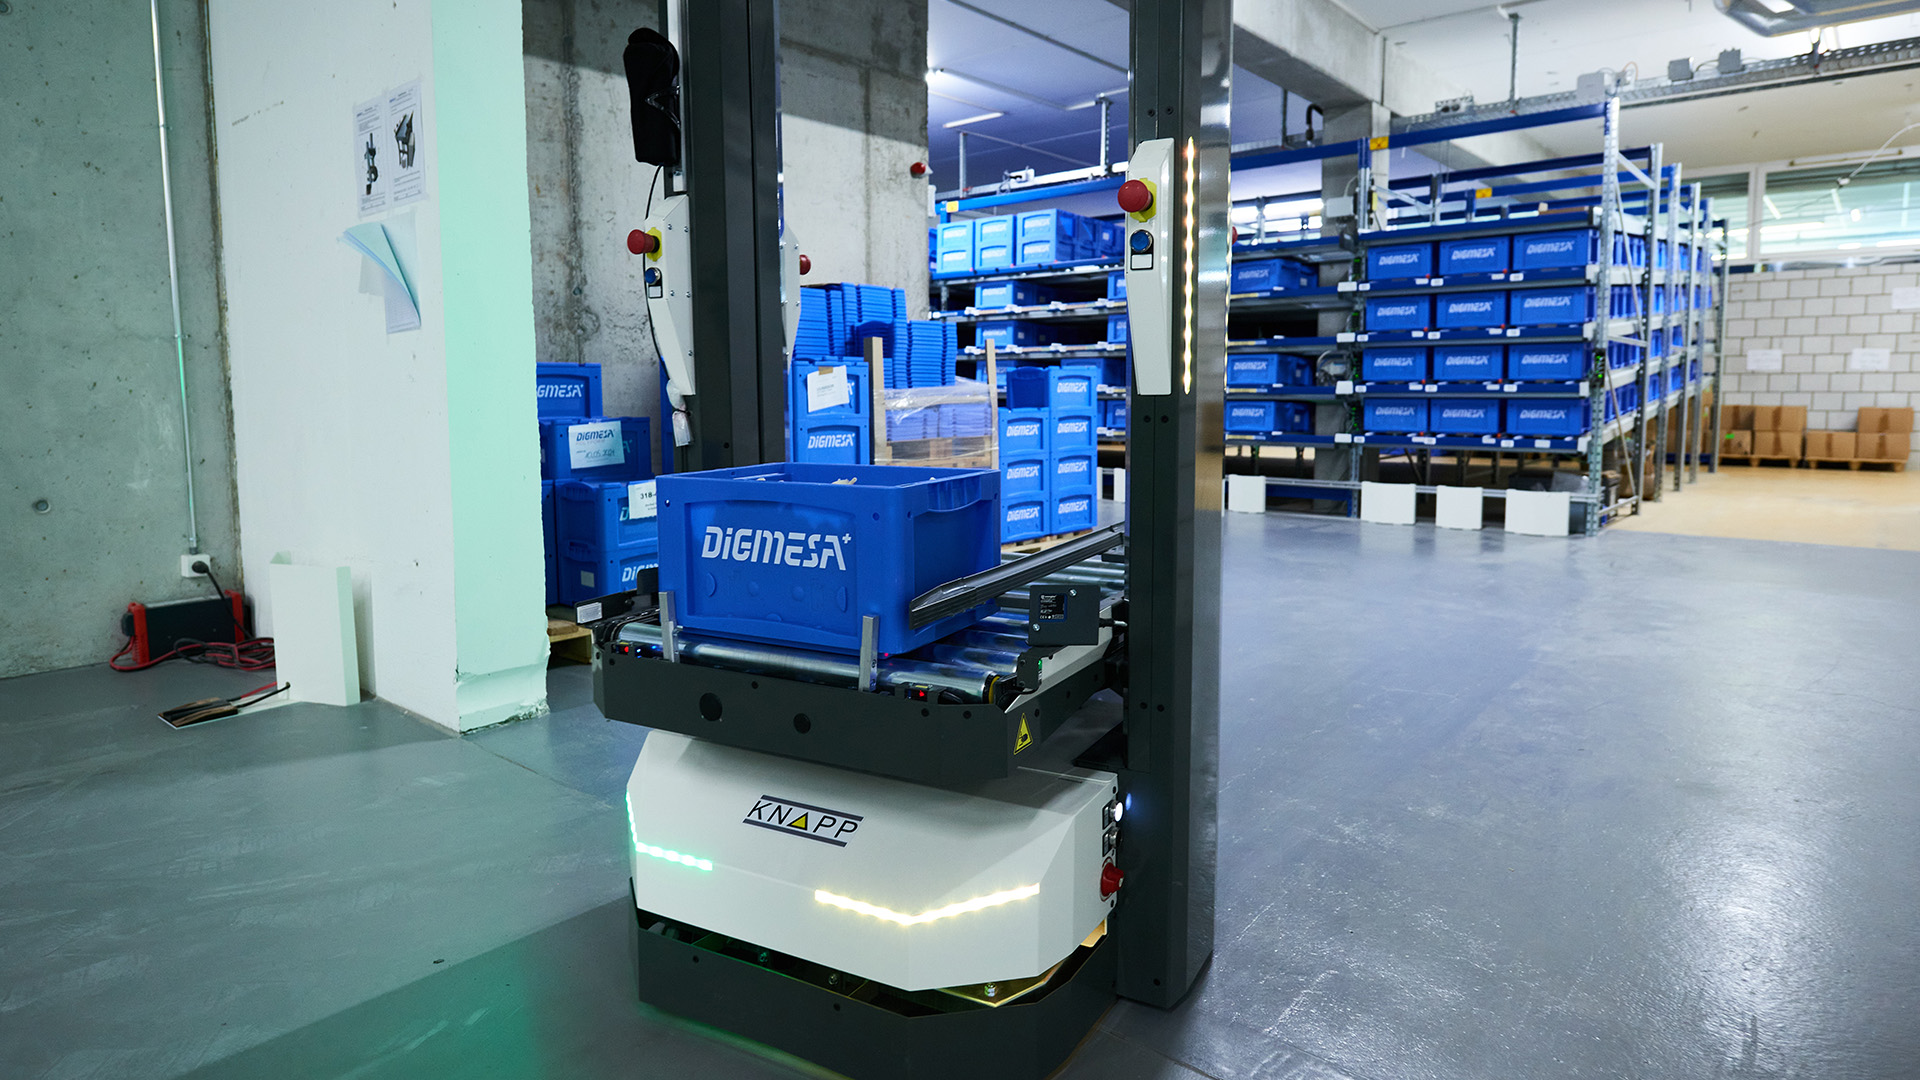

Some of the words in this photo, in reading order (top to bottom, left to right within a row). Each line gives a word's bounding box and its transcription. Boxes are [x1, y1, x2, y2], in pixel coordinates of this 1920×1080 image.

[537, 384, 584, 398] GMESA
[640, 491, 657, 500] 318-
[746, 800, 859, 839] KNAPP
